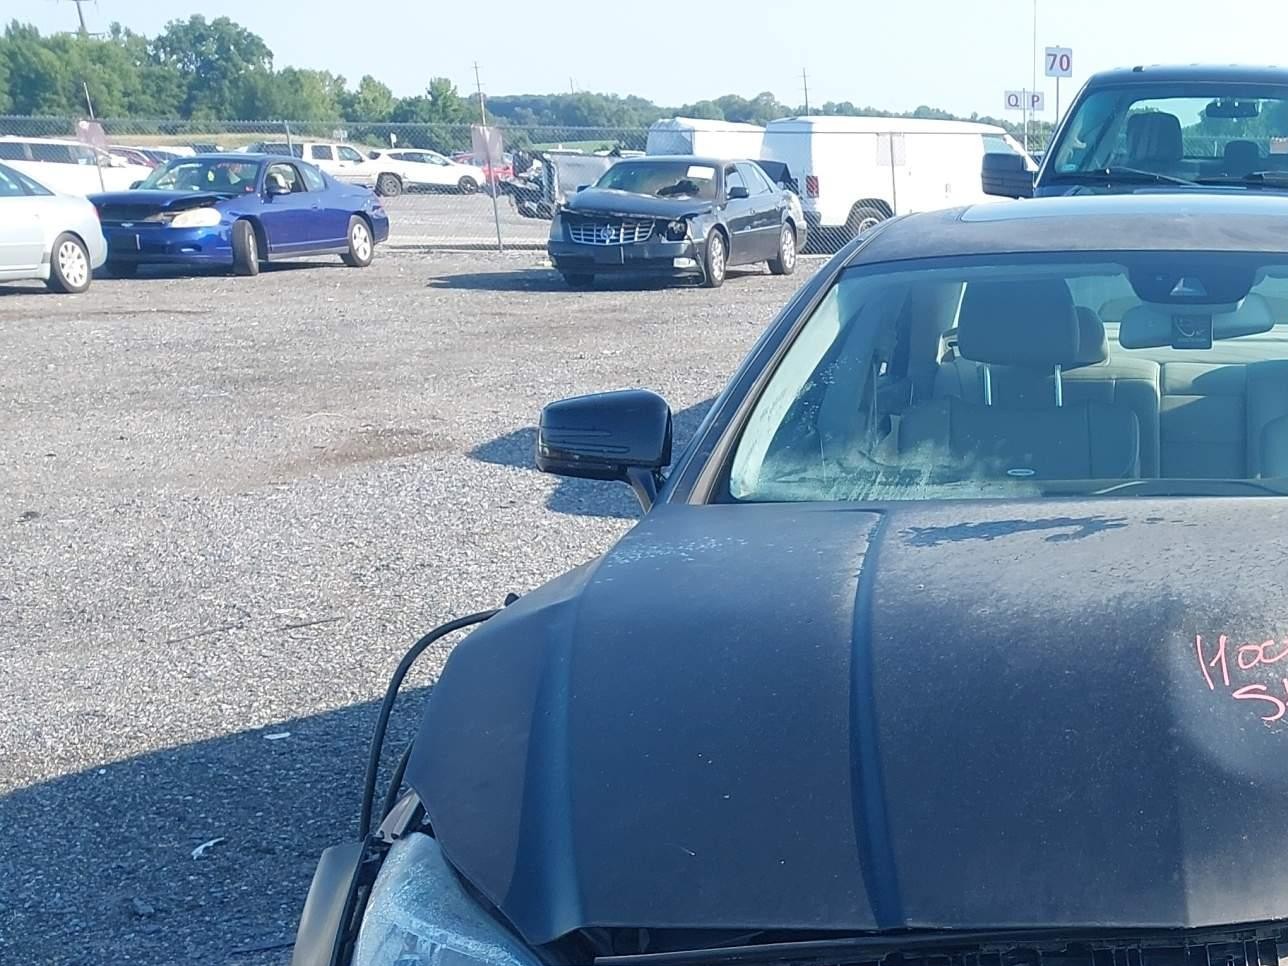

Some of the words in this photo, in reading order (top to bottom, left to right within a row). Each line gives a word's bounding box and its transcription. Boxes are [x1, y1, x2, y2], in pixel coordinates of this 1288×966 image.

[1046, 53, 1071, 72] 70
[1008, 94, 1020, 107] Q
[1031, 94, 1041, 108] P
